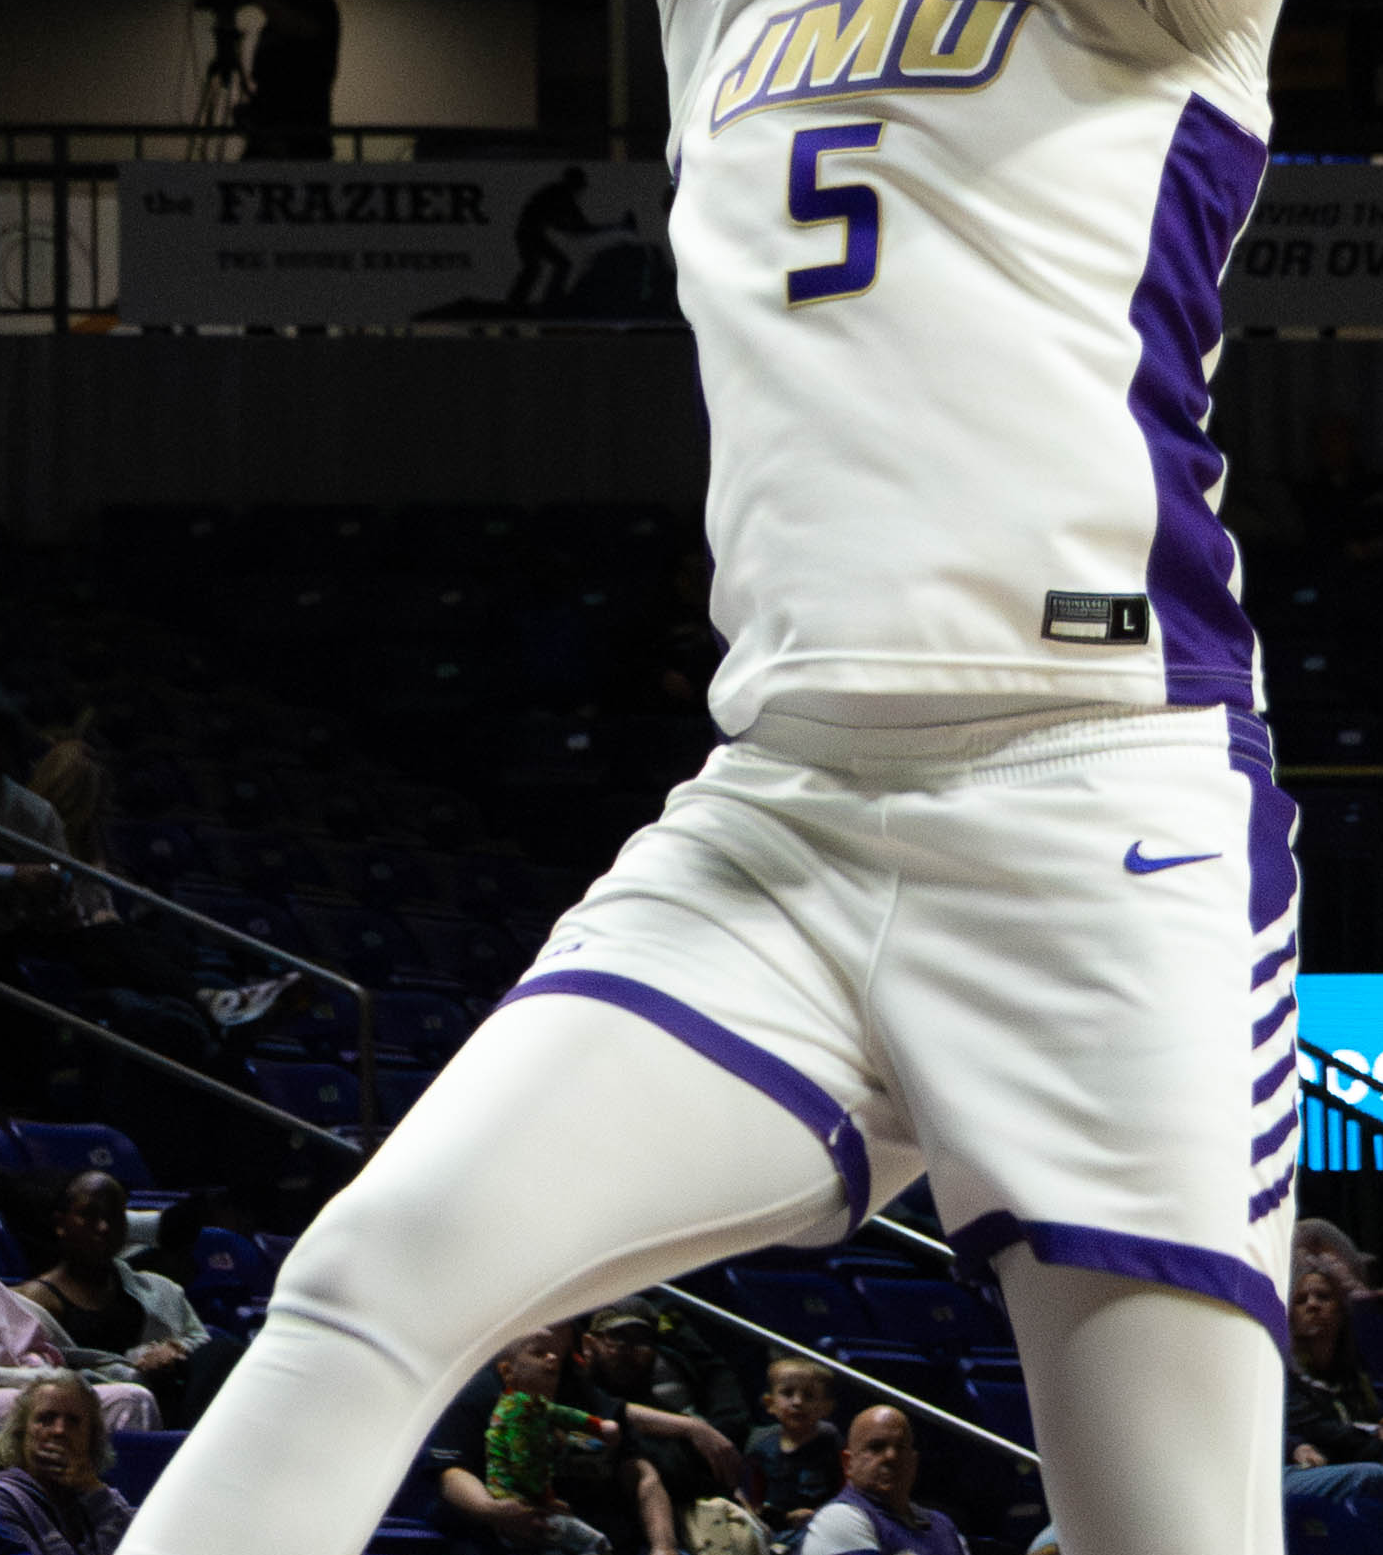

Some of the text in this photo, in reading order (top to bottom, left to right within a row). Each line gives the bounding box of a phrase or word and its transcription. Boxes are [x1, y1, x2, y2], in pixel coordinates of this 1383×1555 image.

[217, 180, 490, 225] FRAZIER
[785, 119, 887, 311] 5
[1123, 609, 1135, 630] L
